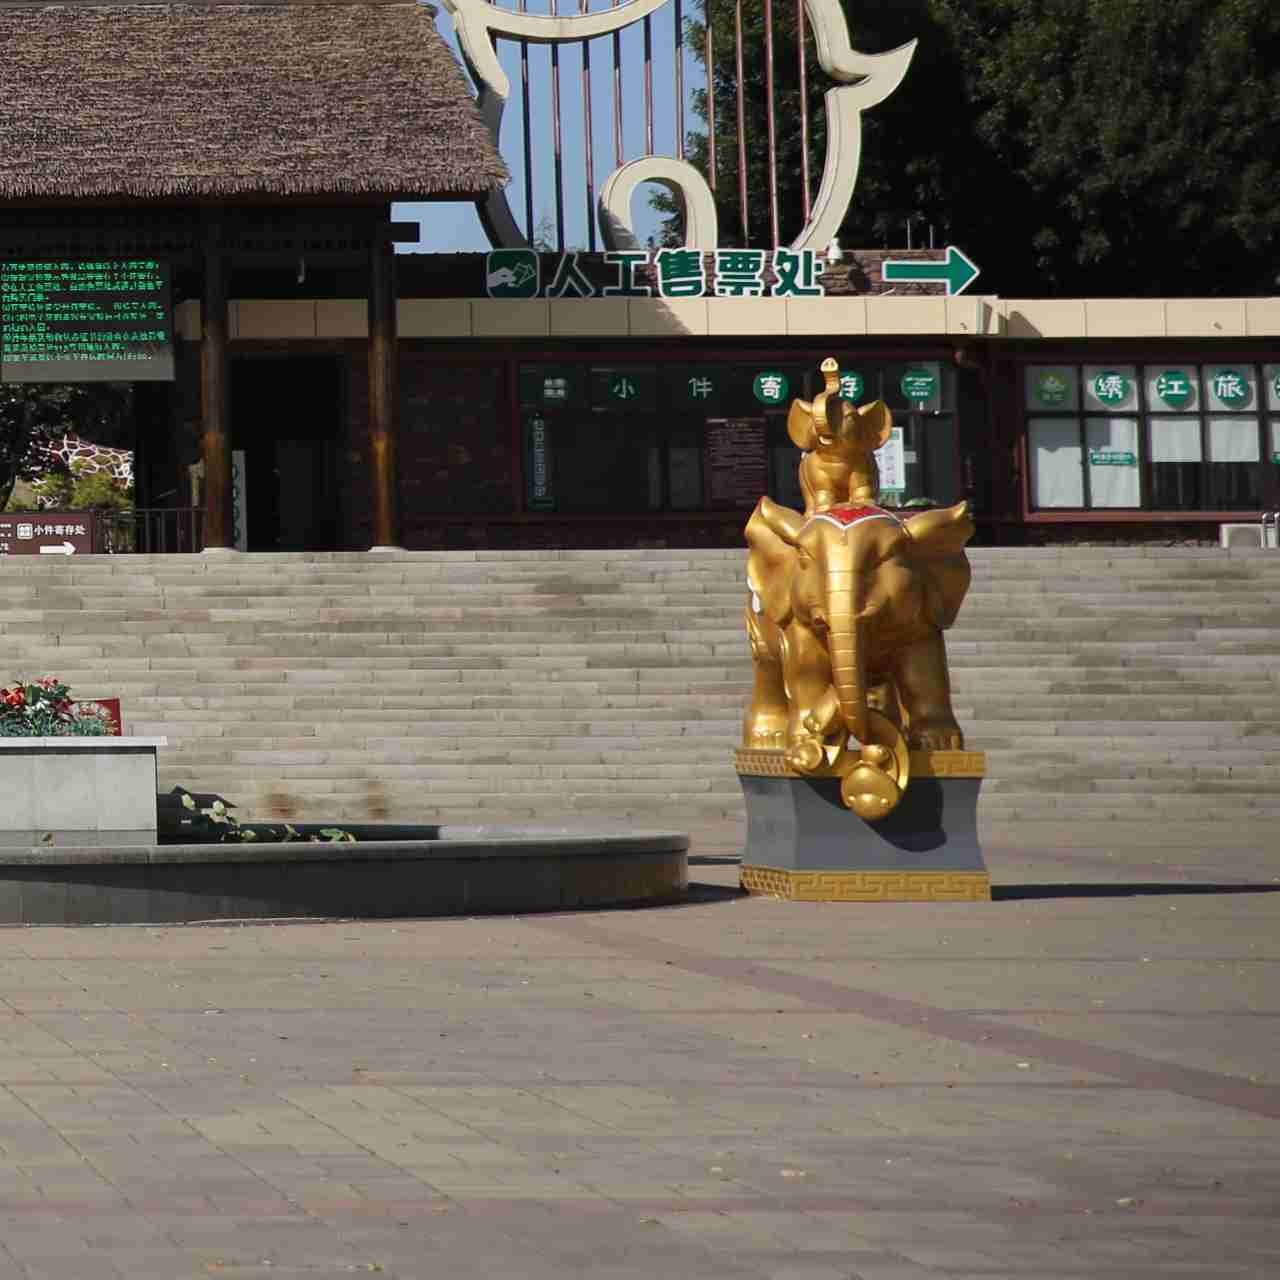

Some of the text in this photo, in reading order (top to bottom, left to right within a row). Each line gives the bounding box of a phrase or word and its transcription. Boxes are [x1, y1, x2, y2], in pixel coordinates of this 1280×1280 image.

[546, 248, 826, 298] 人工售票处
[33, 524, 86, 537] 小件寄存处
